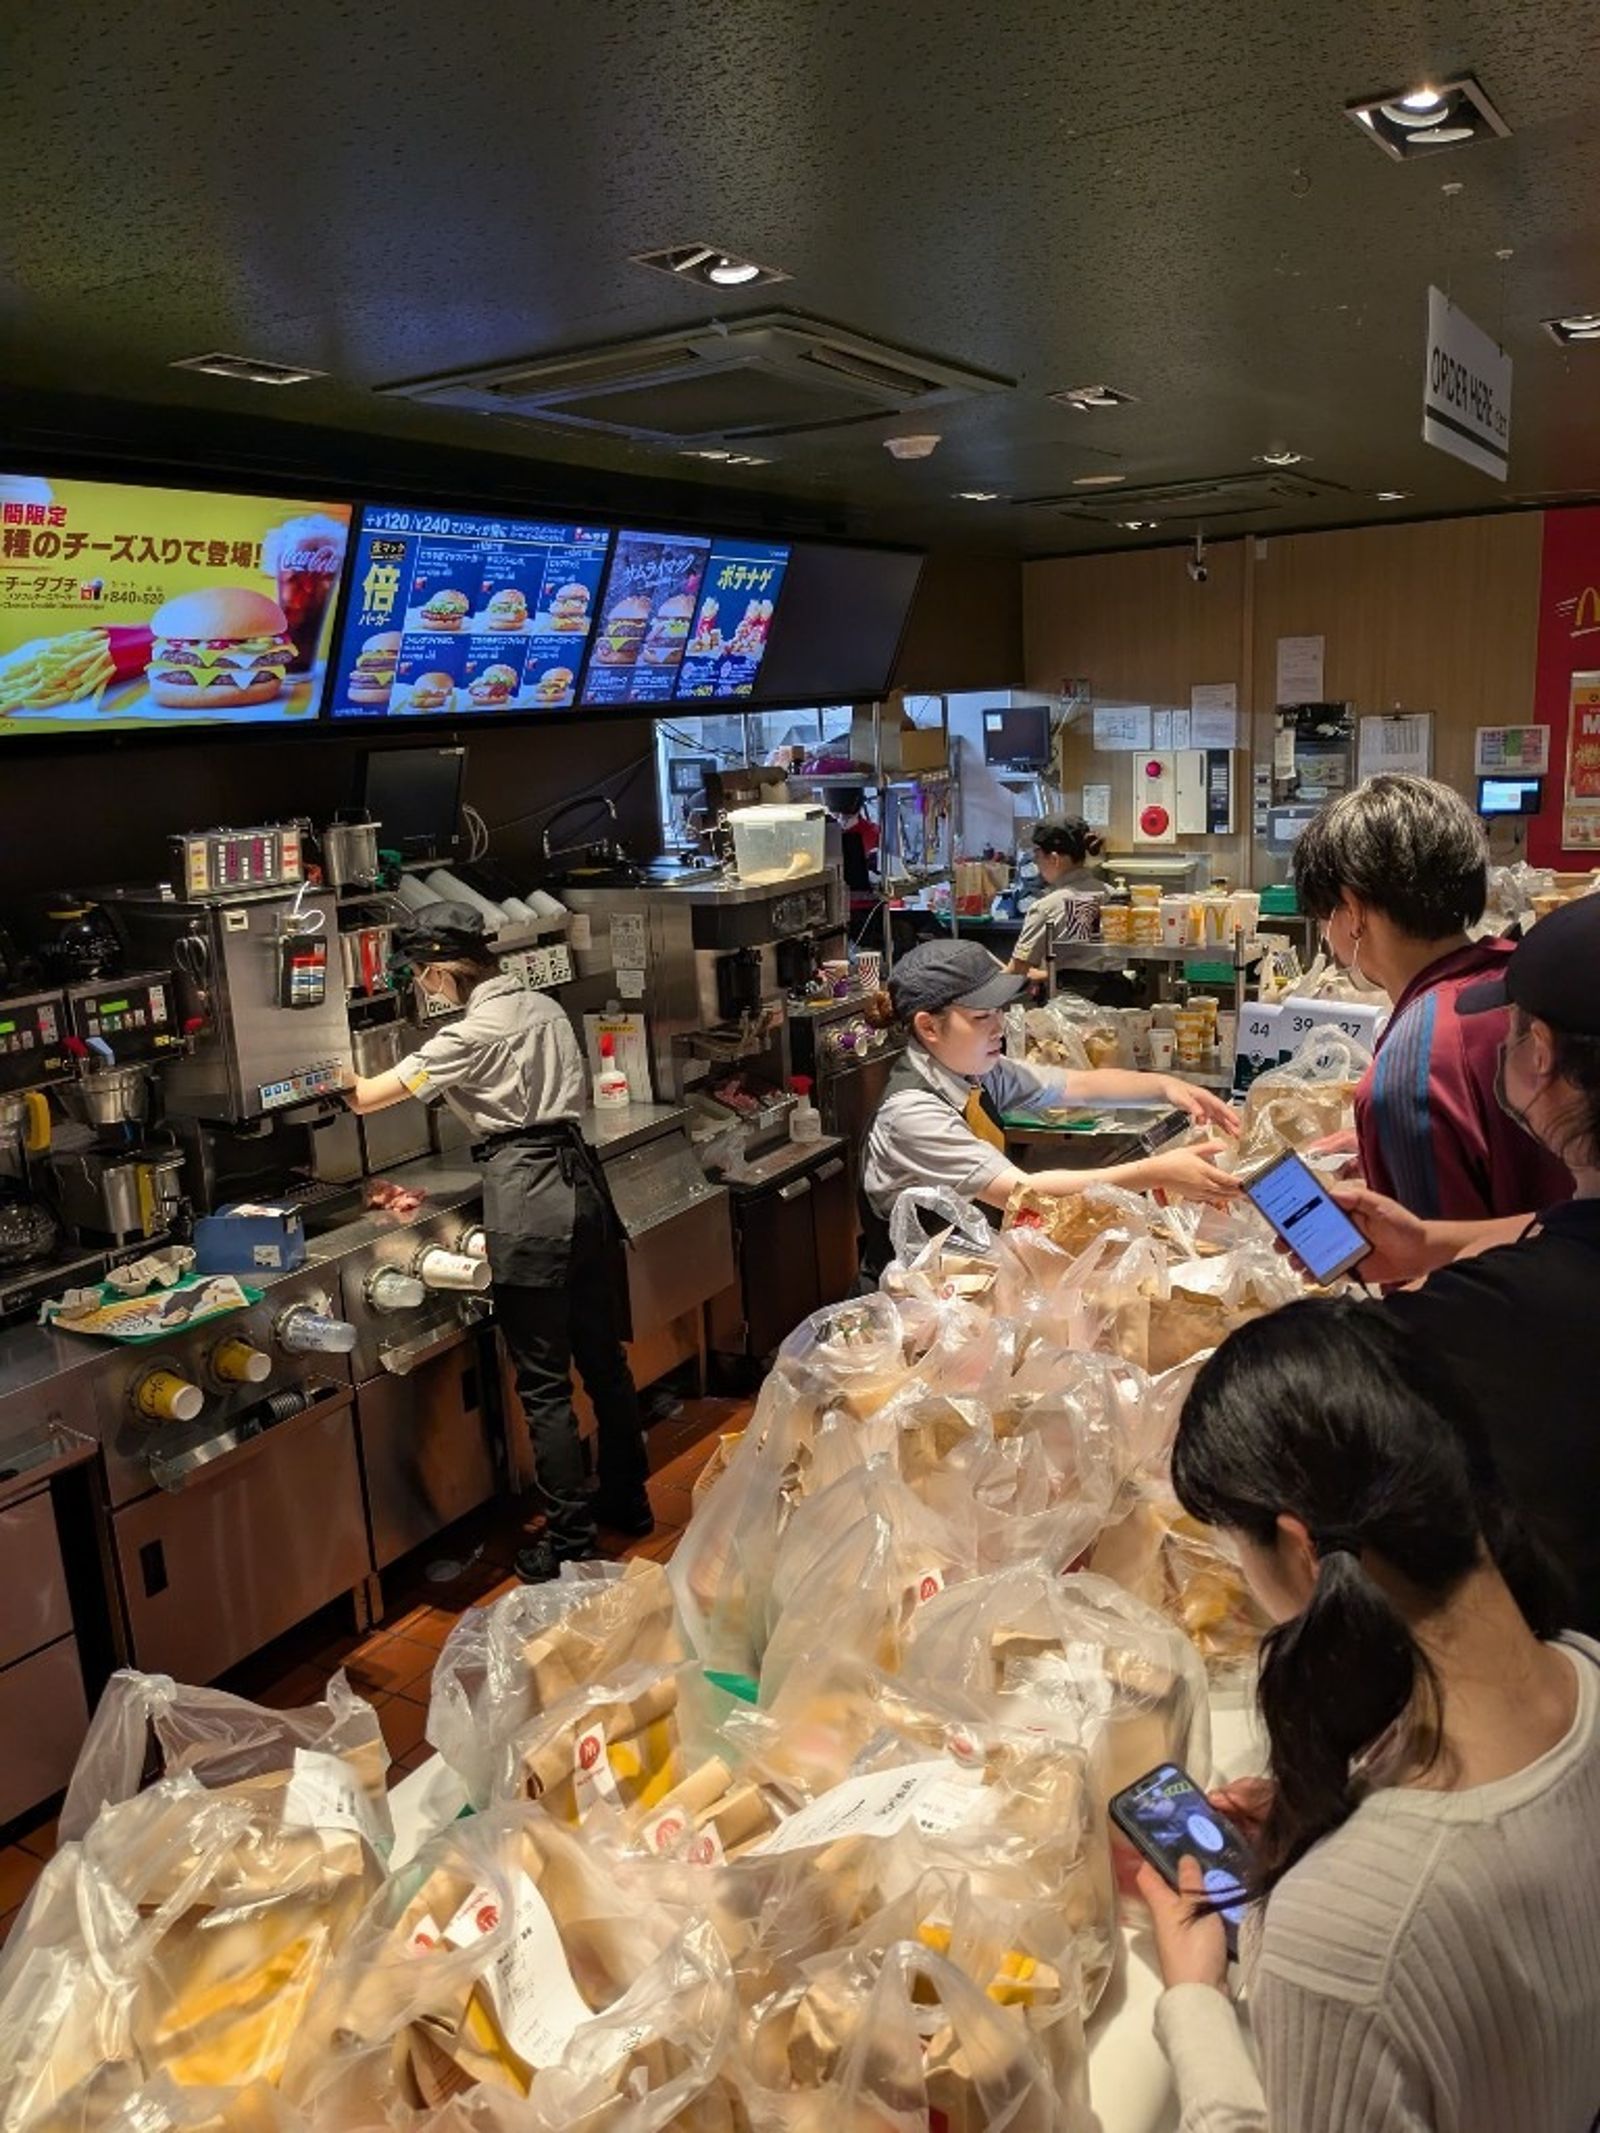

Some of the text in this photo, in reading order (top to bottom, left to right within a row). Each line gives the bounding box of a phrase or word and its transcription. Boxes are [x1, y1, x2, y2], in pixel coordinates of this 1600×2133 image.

[1432, 346, 1468, 413] ORDER
[2, 527, 263, 569] 種のチーズ入りで登場!
[362, 562, 401, 612] 倍
[358, 612, 391, 627] バーガー
[1249, 1022, 1270, 1038] 44
[1293, 1016, 1314, 1033] 39
